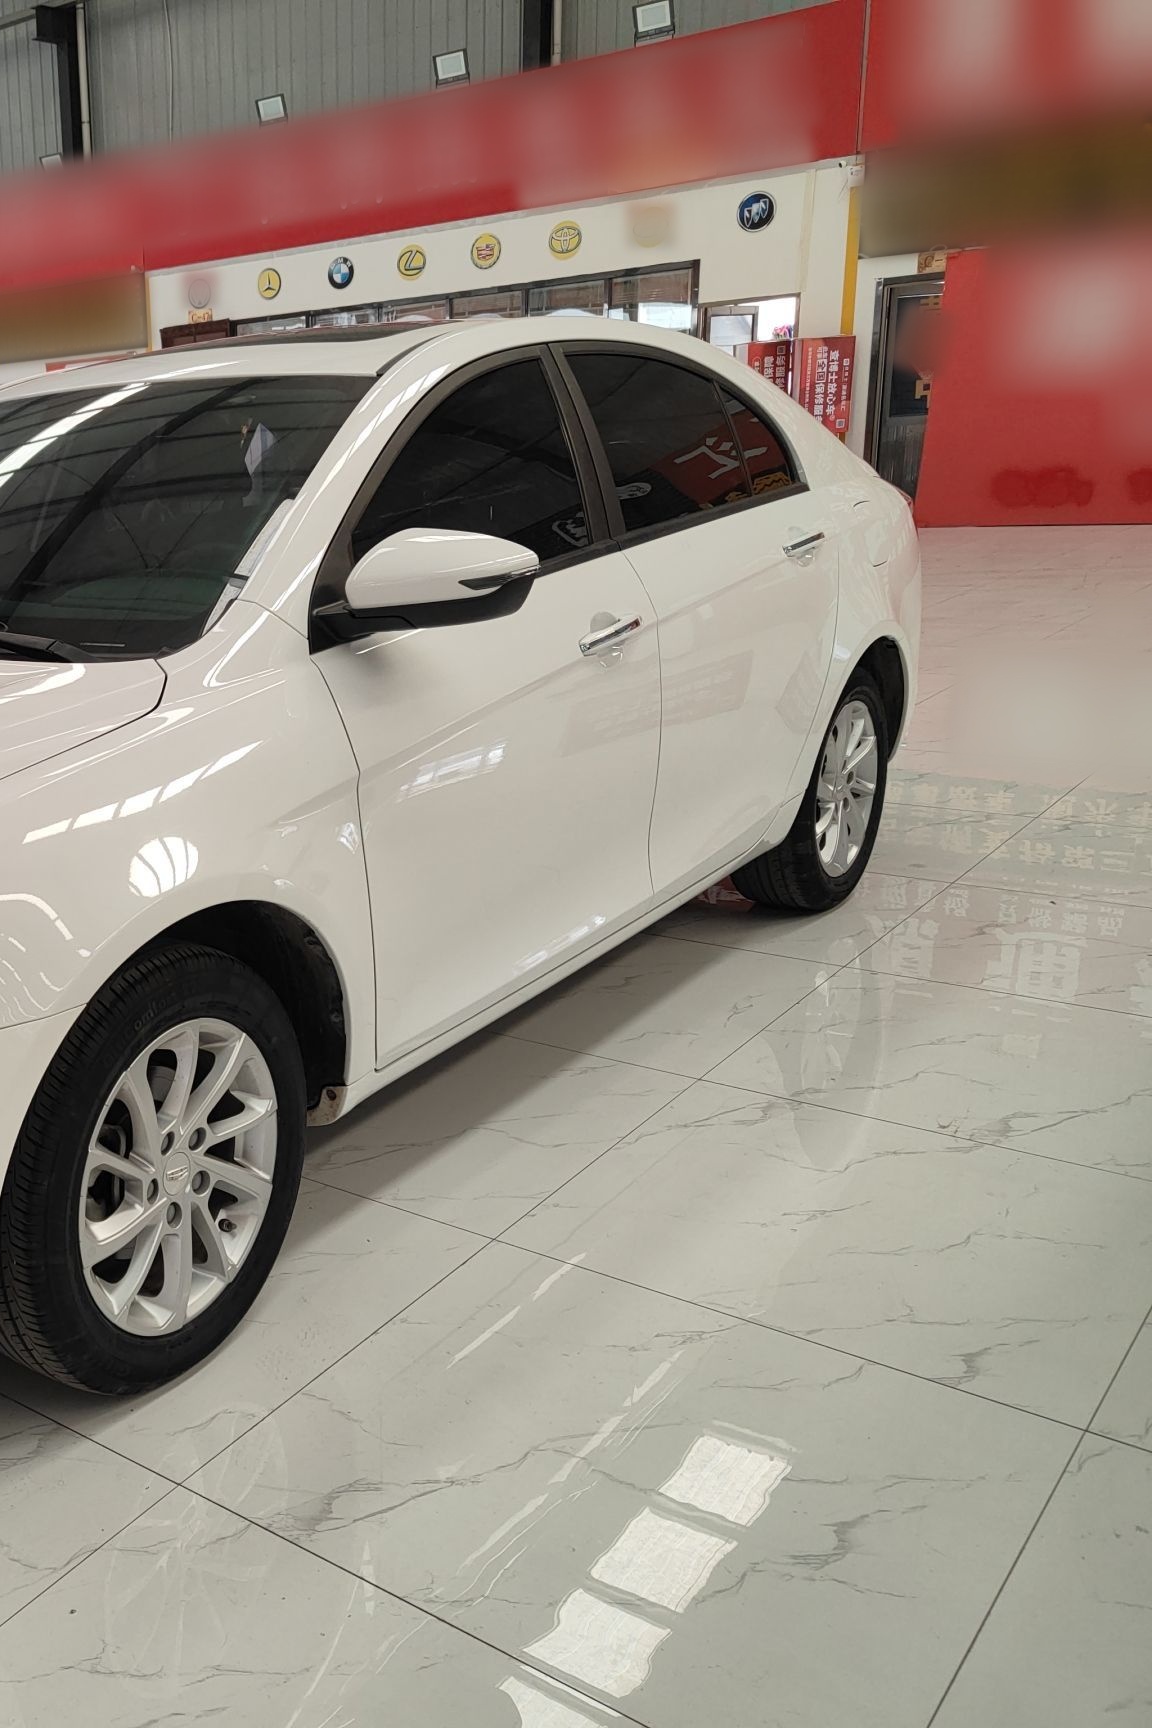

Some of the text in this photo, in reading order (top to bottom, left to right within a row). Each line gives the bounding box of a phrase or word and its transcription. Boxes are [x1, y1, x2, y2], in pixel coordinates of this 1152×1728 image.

[826, 350, 840, 416] 查博士放心车
